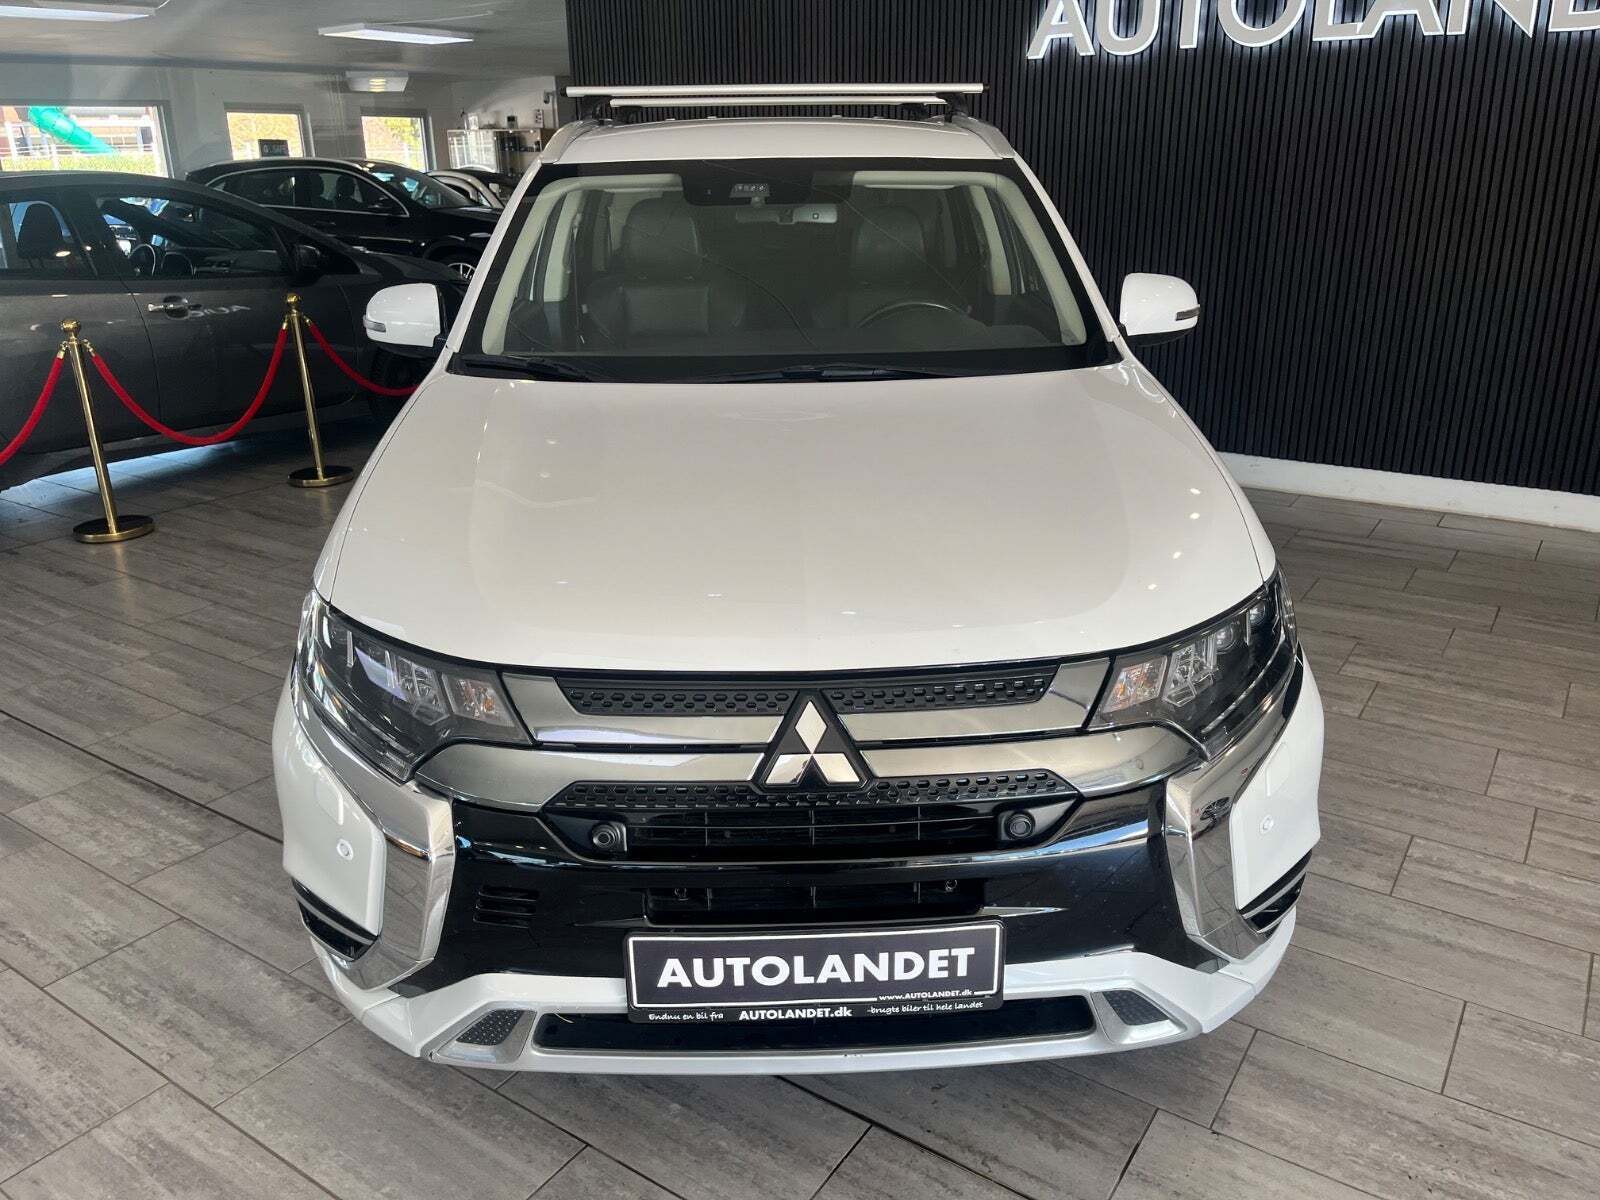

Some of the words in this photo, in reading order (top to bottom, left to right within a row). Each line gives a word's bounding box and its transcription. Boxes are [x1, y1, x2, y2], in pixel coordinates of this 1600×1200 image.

[656, 947, 975, 988] AUTOLANDET
[879, 989, 972, 1001] www.AUTOLANDET.dk
[901, 1004, 921, 1012] biler
[922, 1003, 934, 1011] til
[935, 1003, 953, 1011] hele
[954, 1001, 984, 1010] landet
[709, 1012, 724, 1021] fra
[739, 1007, 852, 1020] AUTOLANDET.dk
